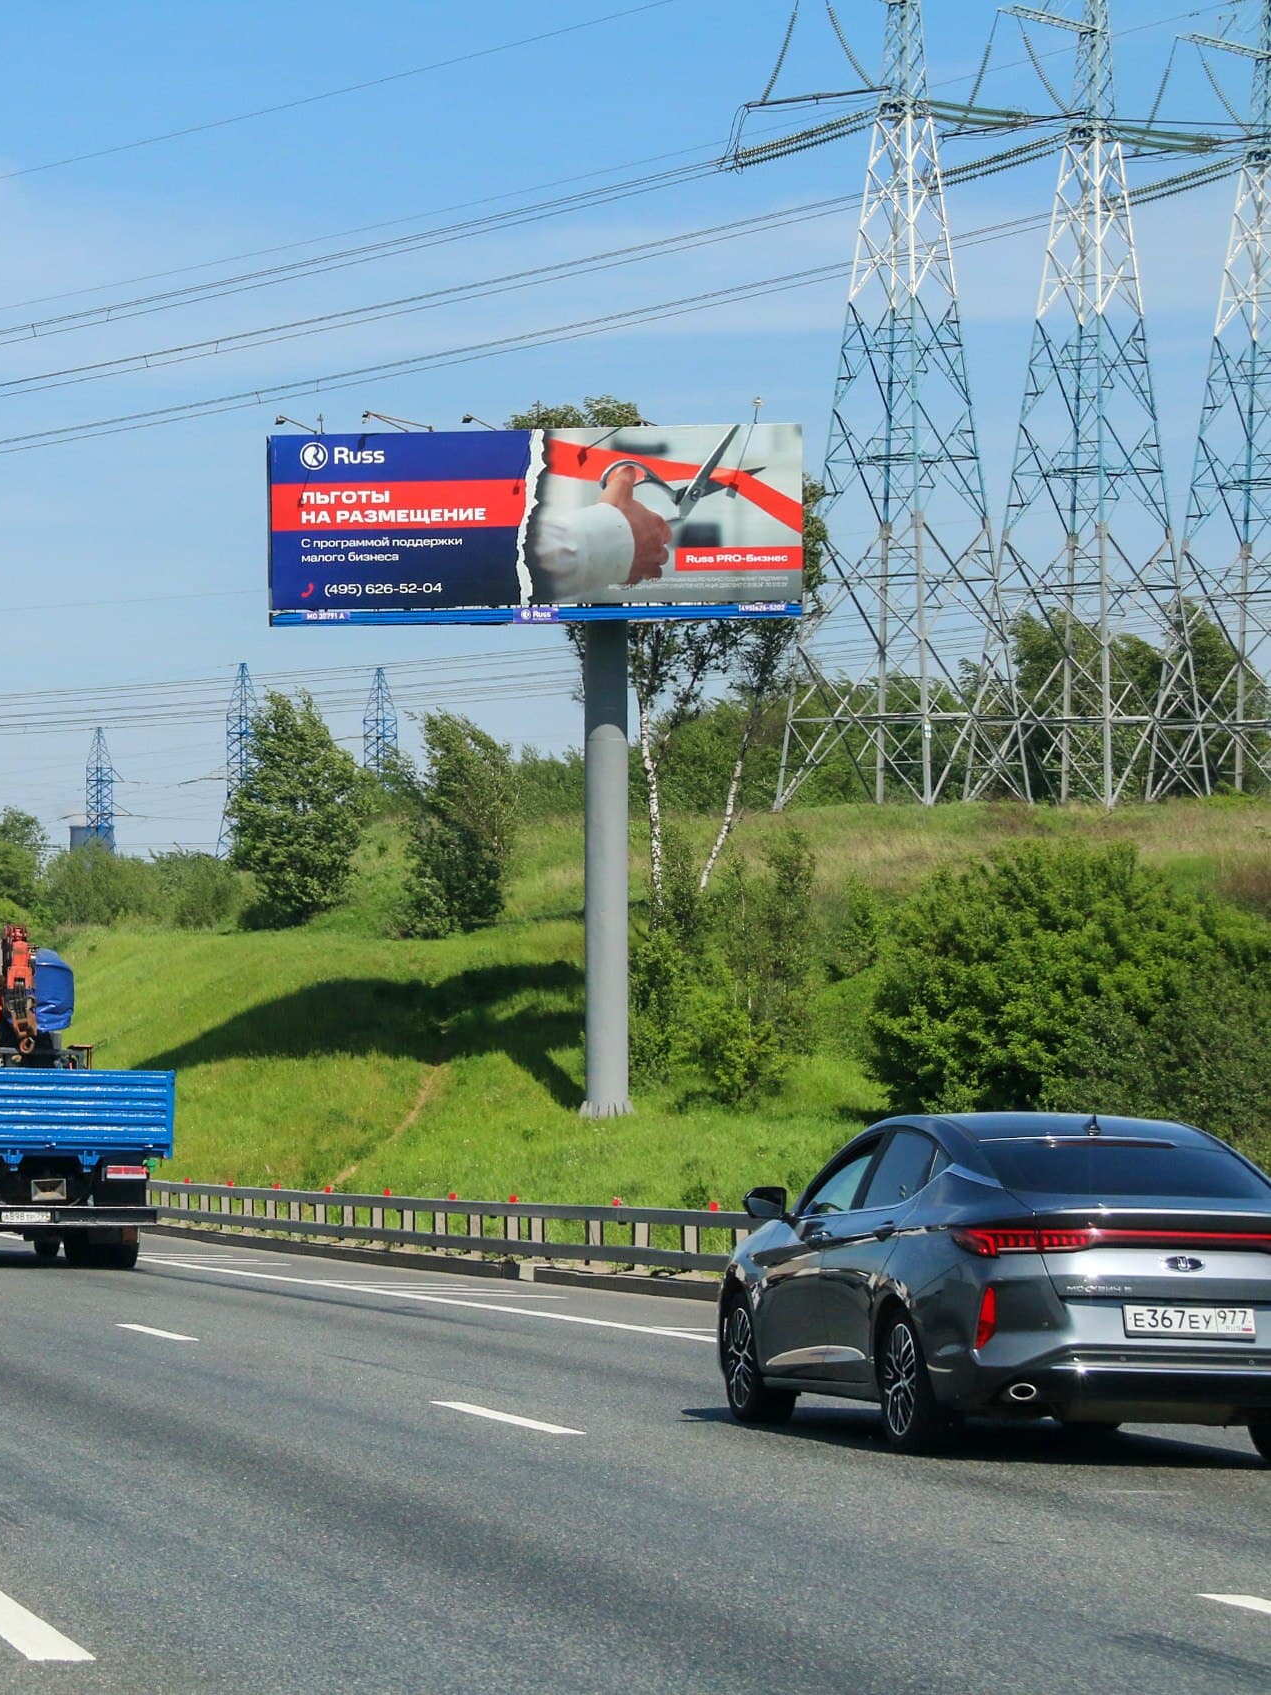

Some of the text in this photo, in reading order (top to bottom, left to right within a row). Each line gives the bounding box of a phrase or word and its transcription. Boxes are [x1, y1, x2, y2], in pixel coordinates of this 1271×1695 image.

[333, 446, 385, 465] Russ
[301, 490, 390, 505] ЛЬГОТЫ
[301, 508, 487, 524] НА РАЗМЕЩЕНИЕ
[301, 537, 463, 550] С программой поддержки
[301, 551, 399, 563] малого бизнеса
[686, 553, 789, 563] Russ PRO-Бизнес
[324, 582, 443, 597] (495) 626-52-04
[1133, 1309, 1247, 1330] Е367ЕУ 977
